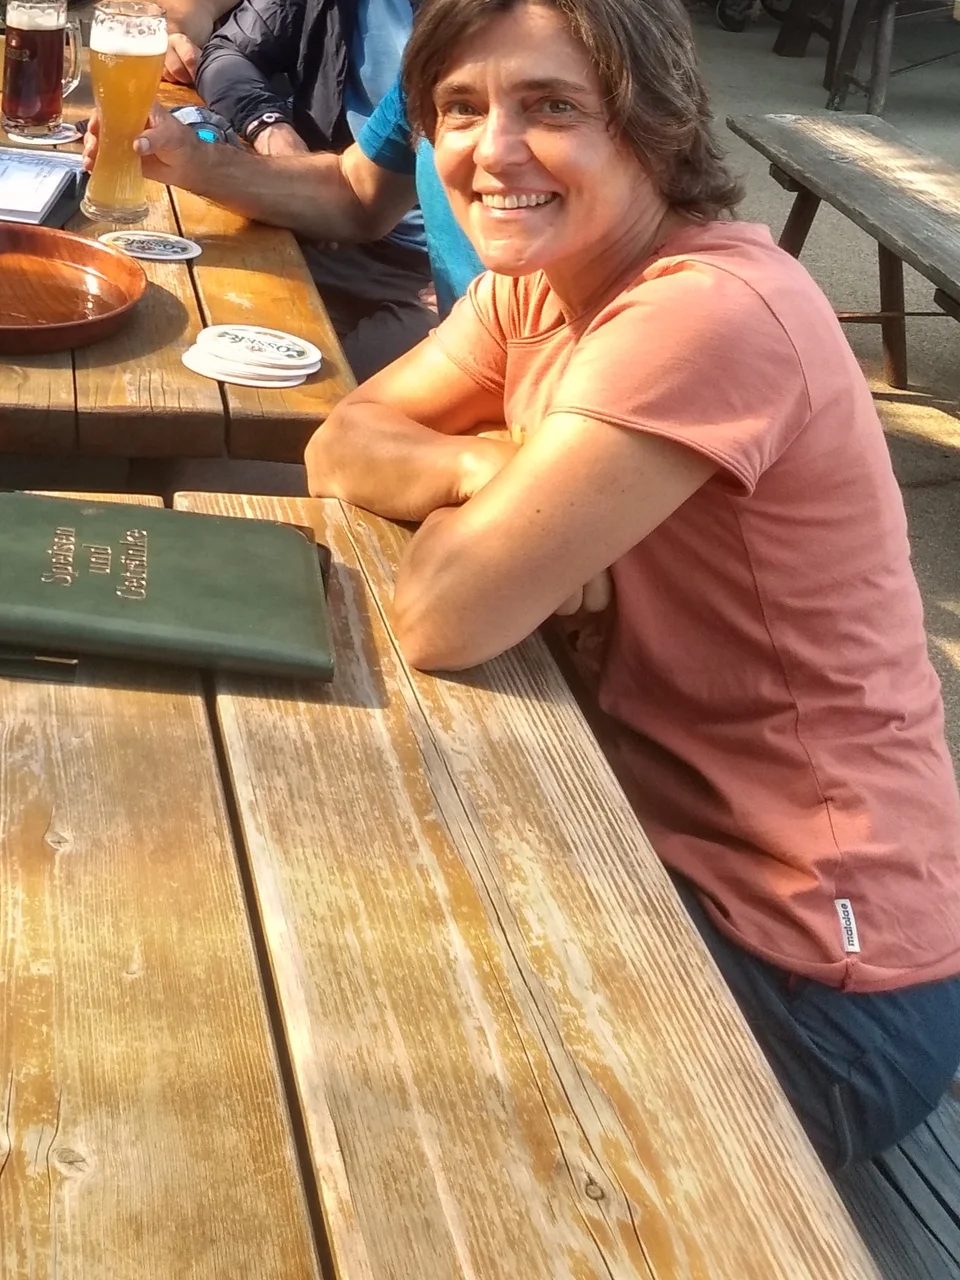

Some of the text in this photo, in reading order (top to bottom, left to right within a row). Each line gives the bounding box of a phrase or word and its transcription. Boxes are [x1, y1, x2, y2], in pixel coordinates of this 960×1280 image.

[40, 526, 78, 587] Speisen
[82, 543, 112, 574] und
[115, 528, 148, 600] Getränke
